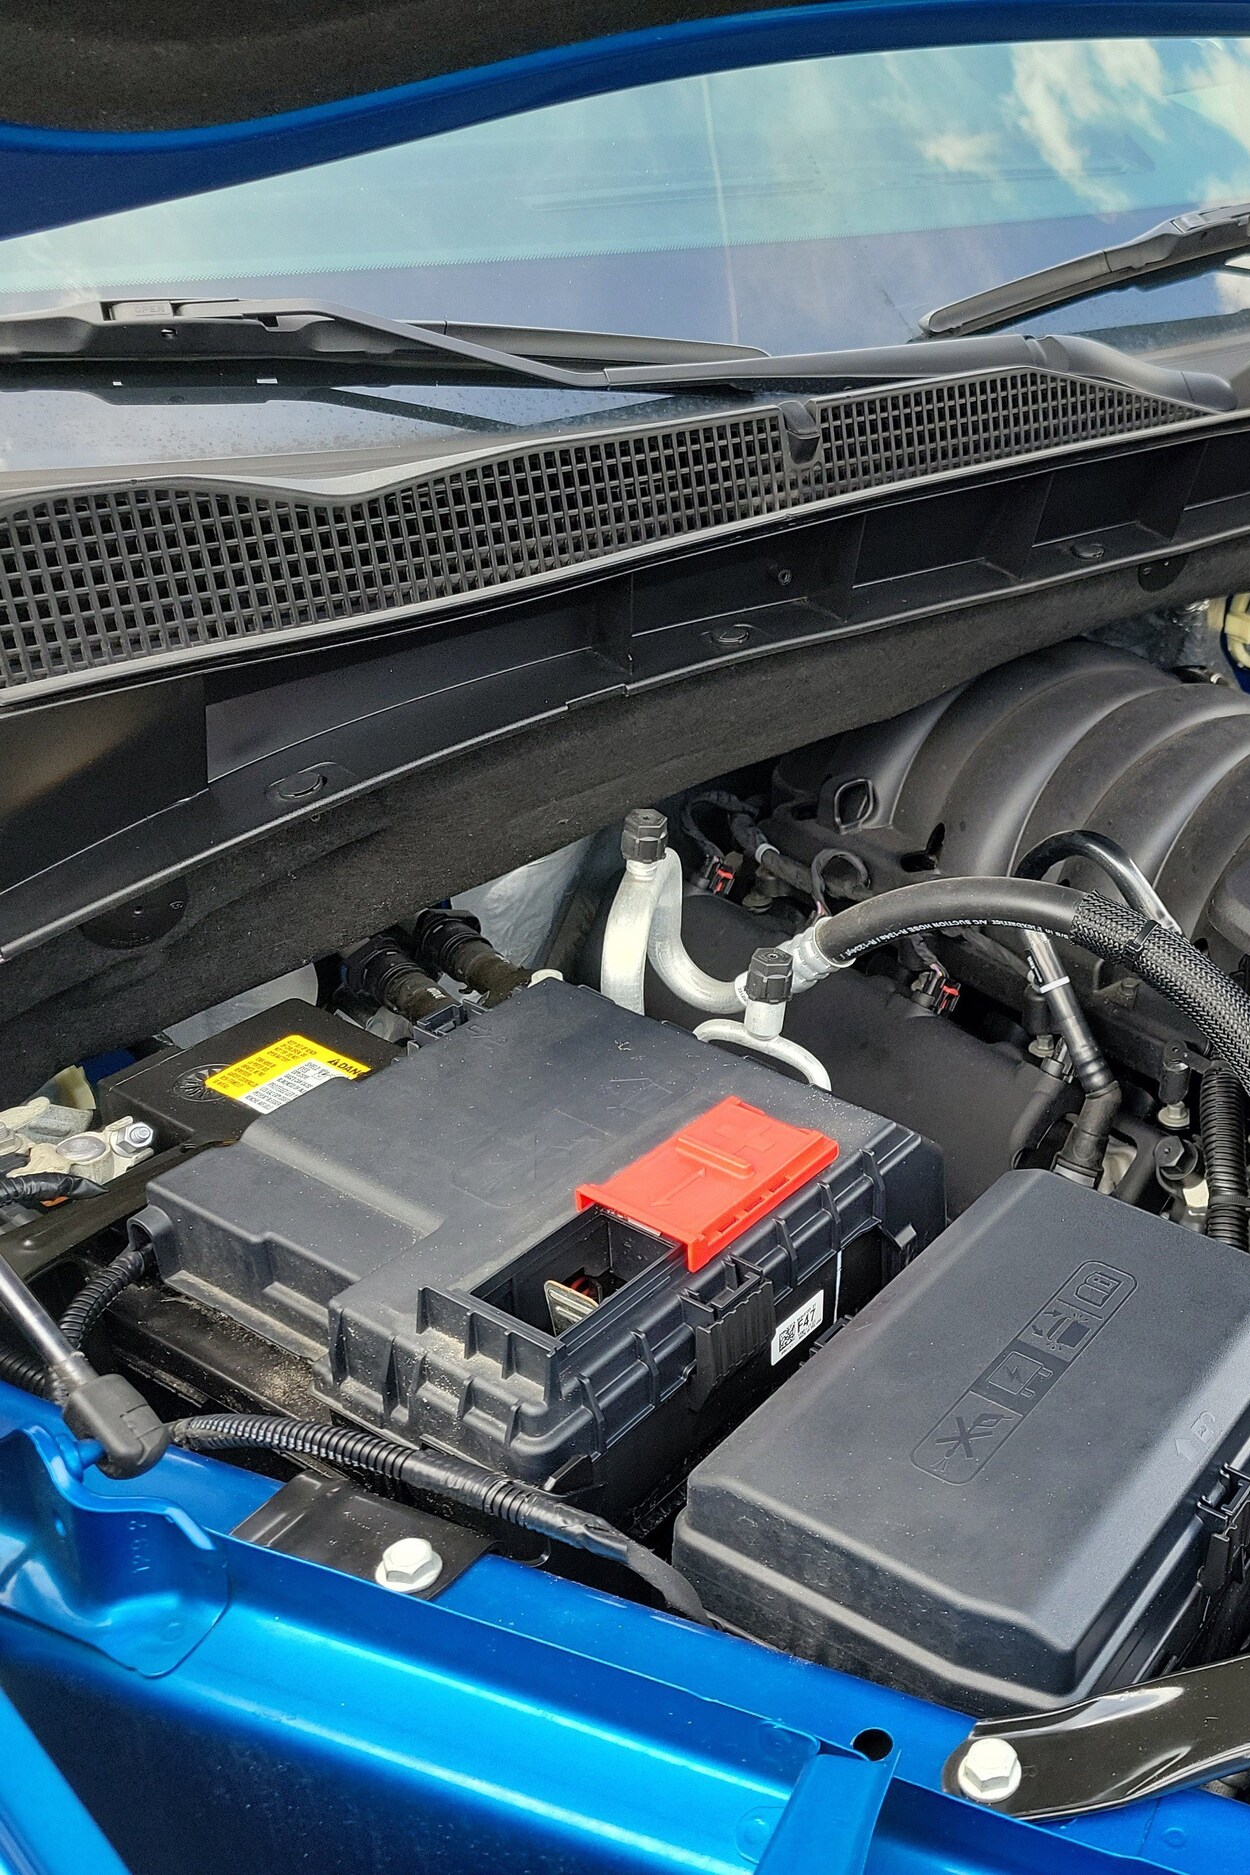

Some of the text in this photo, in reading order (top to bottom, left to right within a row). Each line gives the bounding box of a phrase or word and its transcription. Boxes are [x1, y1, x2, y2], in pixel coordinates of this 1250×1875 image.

[907, 923, 933, 933] HOSE
[932, 919, 972, 928] SUCTION
[338, 1062, 364, 1076] DAN
[797, 1308, 816, 1333] F47
